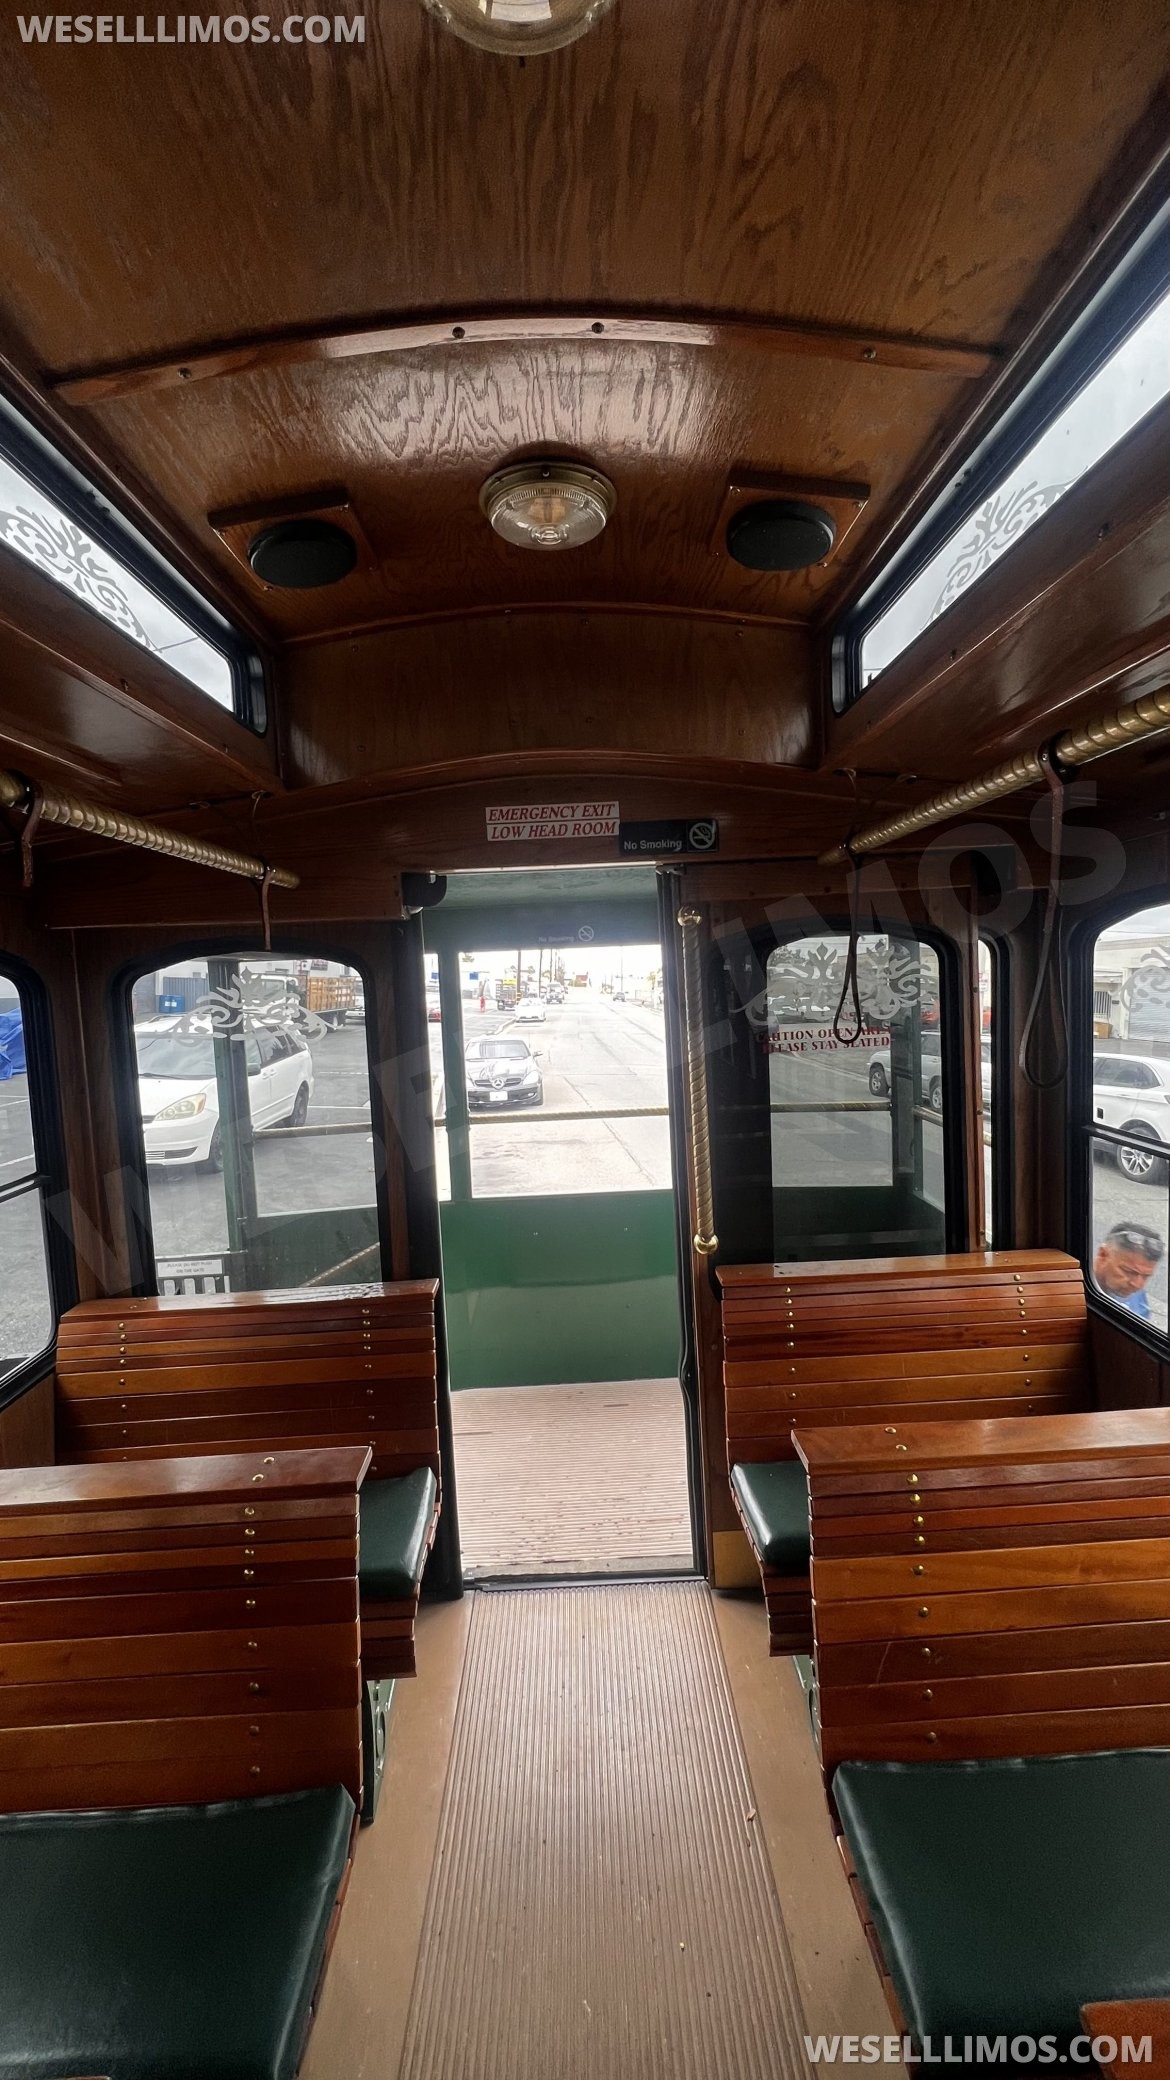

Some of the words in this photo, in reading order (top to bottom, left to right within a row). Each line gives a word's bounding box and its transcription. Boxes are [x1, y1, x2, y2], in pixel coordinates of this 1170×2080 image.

[487, 805, 580, 822] EMERGENCY
[581, 803, 616, 818] EXIT
[491, 824, 525, 840] LOW
[527, 822, 569, 838] HEAD
[572, 821, 617, 837] ROOM
[623, 840, 638, 850] No
[639, 839, 683, 851] Smoking
[811, 1040, 839, 1051] STAY
